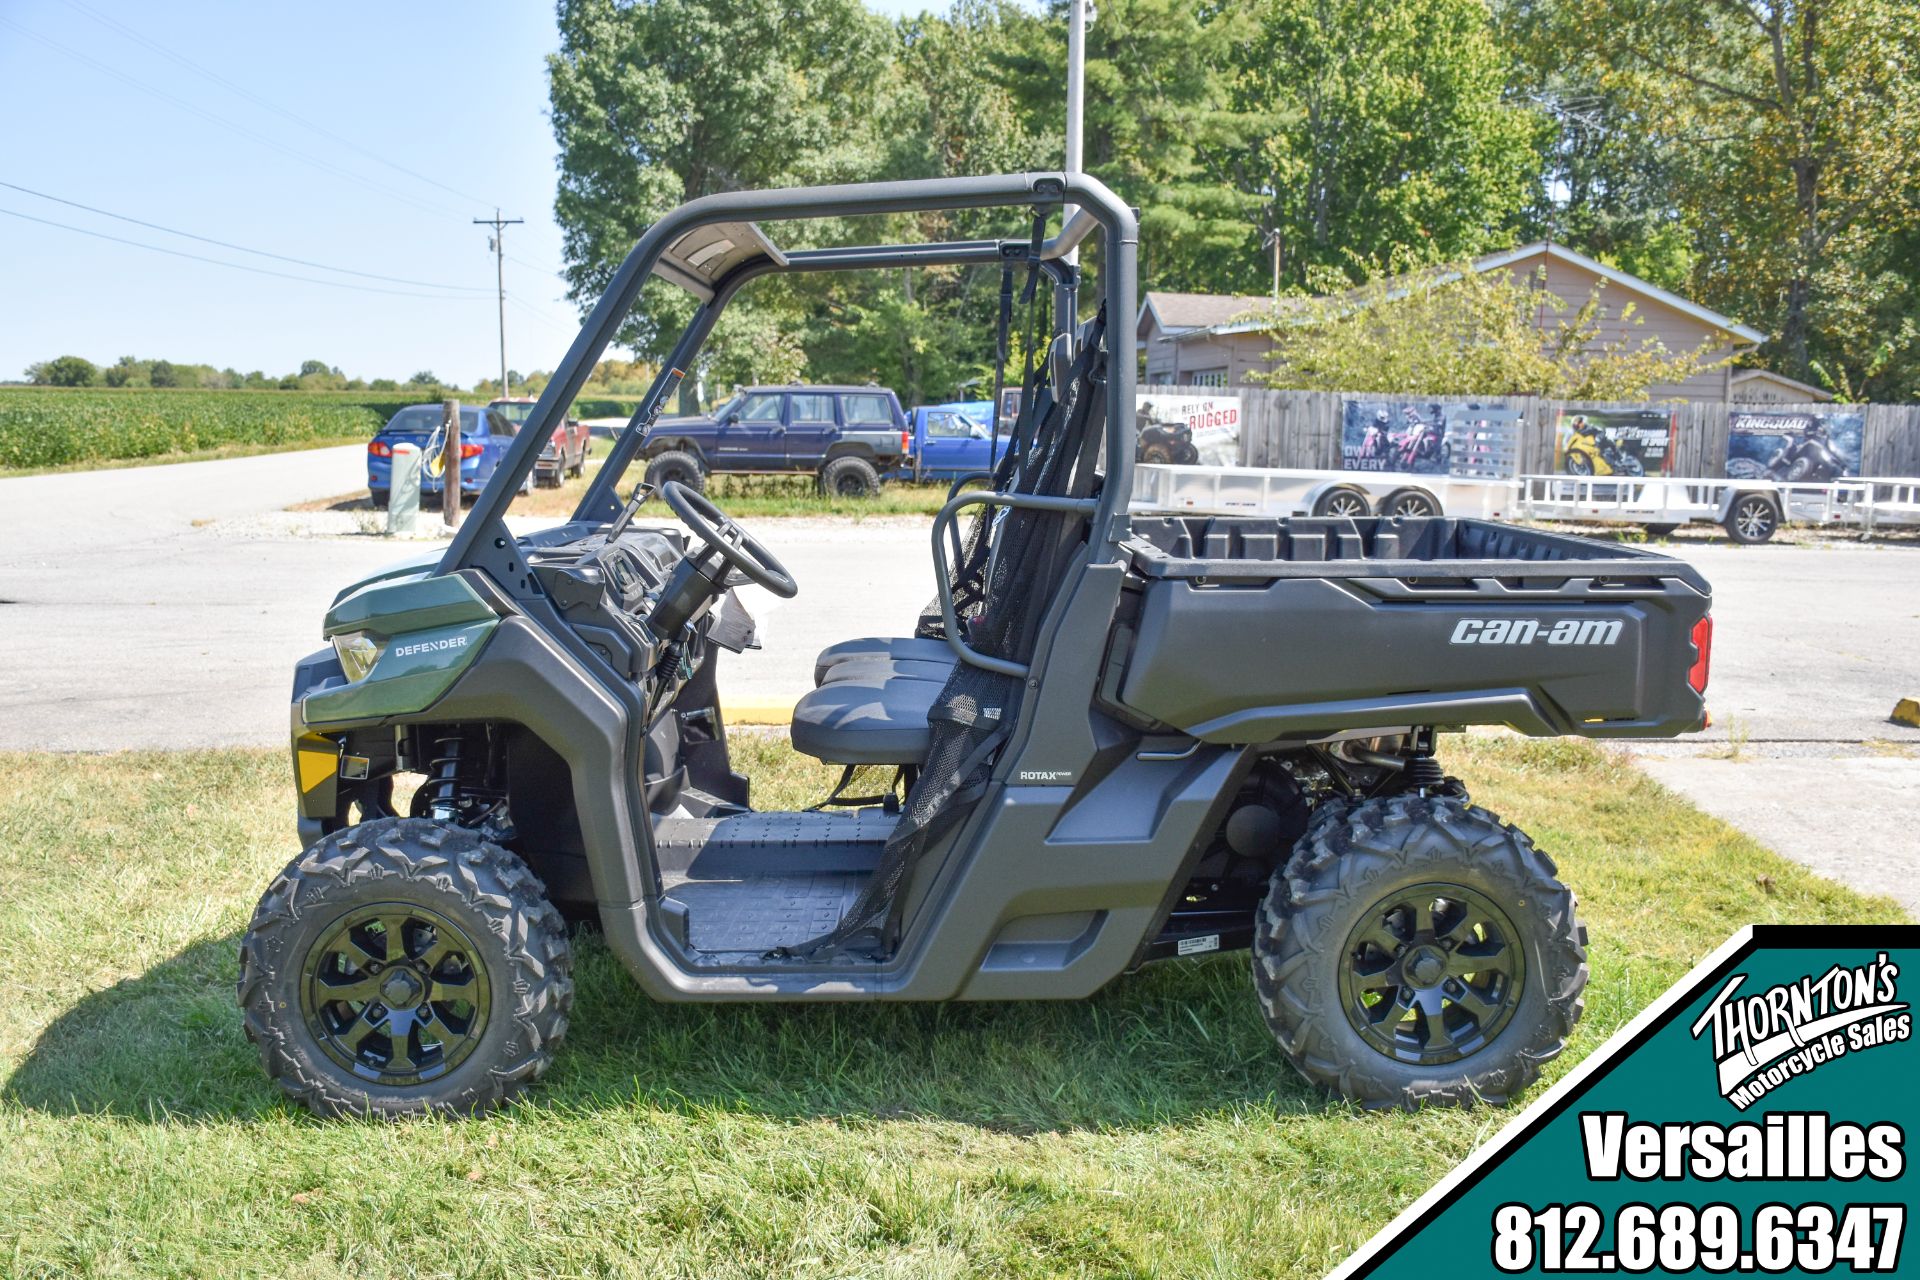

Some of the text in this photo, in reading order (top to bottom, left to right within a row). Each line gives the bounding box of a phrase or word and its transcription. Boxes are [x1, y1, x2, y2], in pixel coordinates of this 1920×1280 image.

[1181, 403, 1199, 416] RELY
[1189, 409, 1237, 430] RUGGED
[1343, 446, 1376, 458] OWN
[1343, 458, 1386, 471] EVERY
[1450, 619, 1623, 645] can-am
[395, 636, 468, 657] DEFENDER
